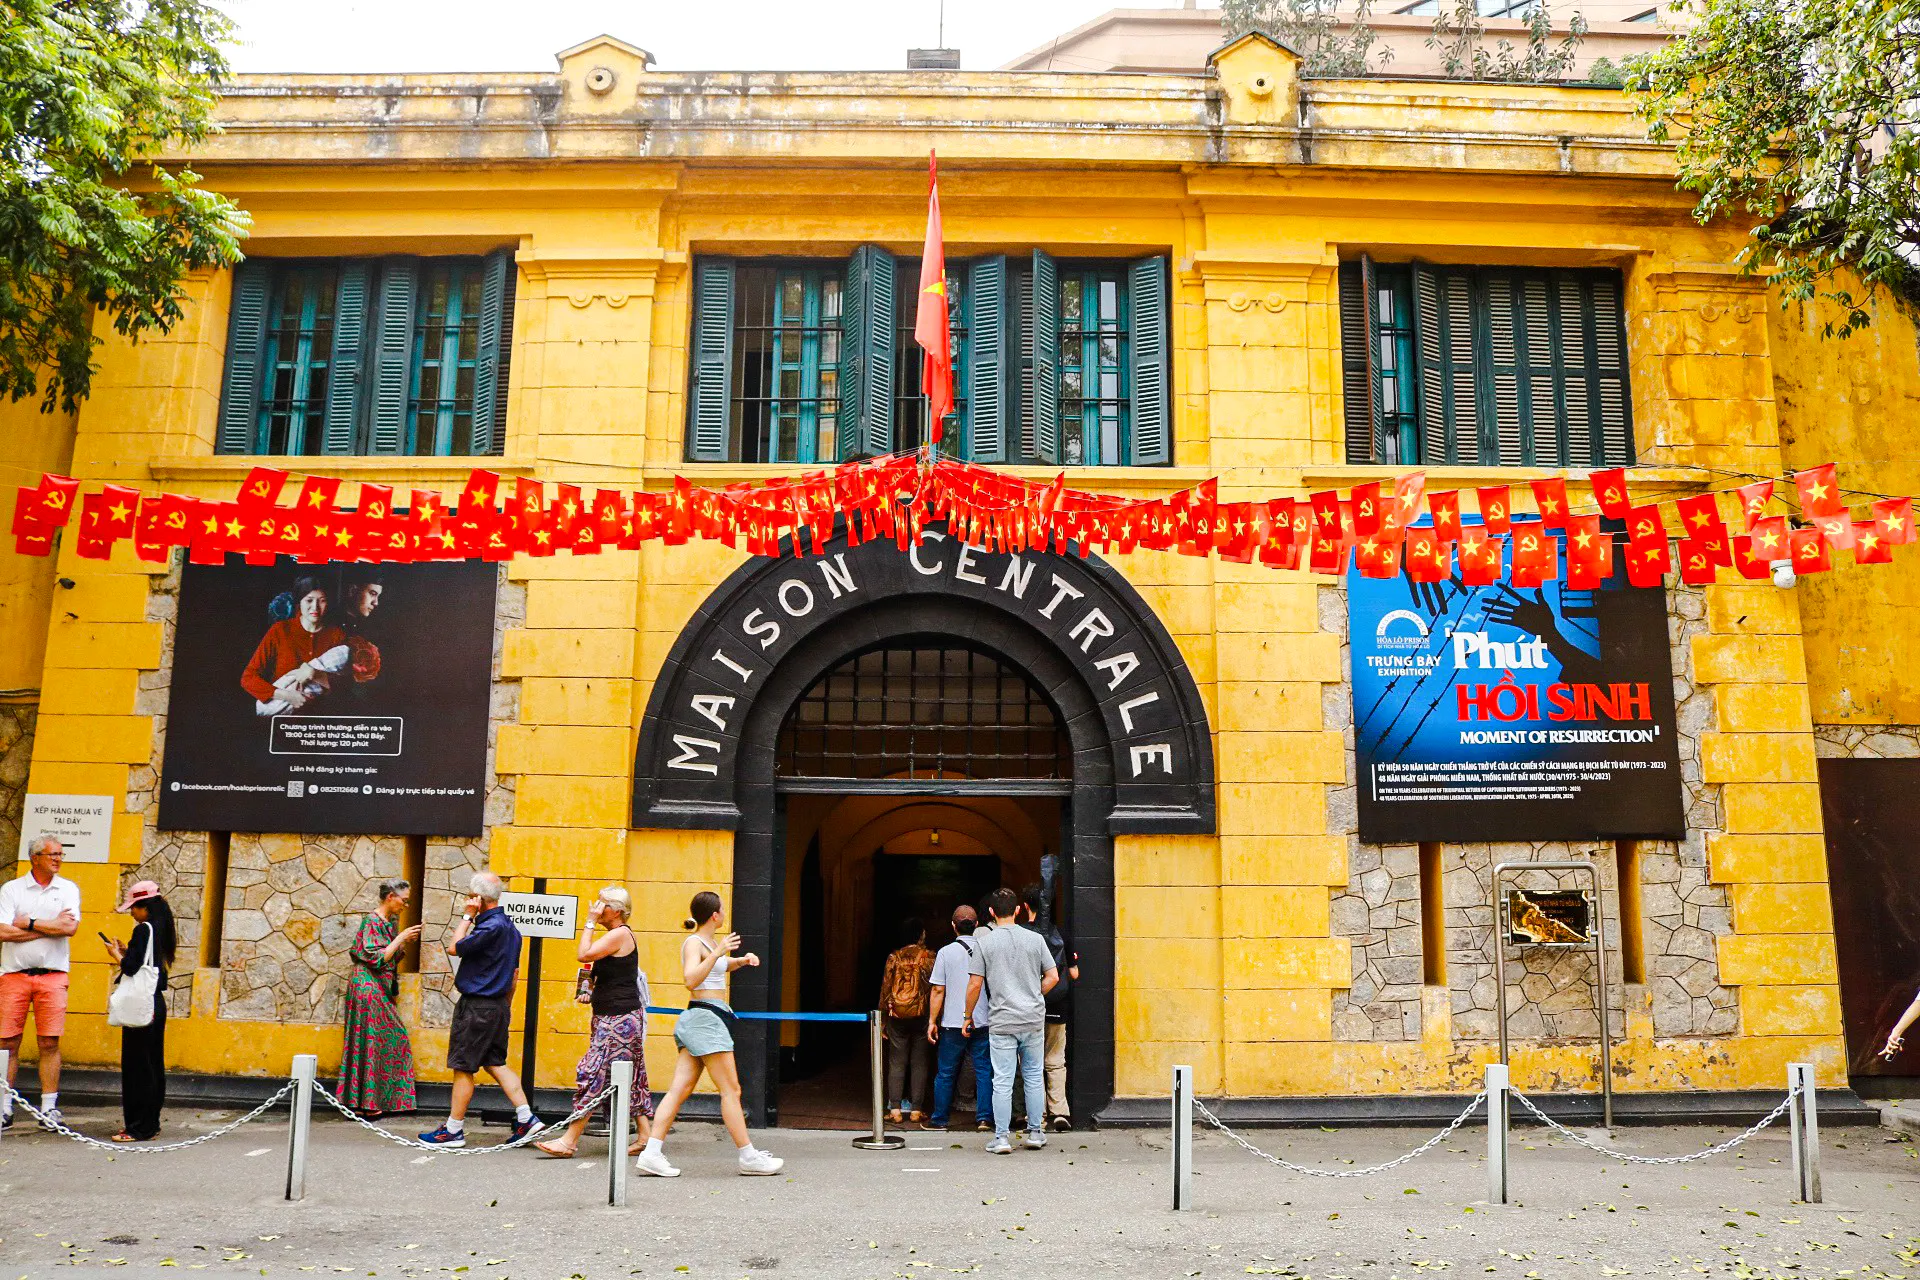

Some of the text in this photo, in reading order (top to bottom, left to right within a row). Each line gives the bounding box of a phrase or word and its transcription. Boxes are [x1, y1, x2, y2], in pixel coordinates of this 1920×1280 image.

[667, 530, 1173, 778] MAISON CENTRALE
[1366, 654, 1441, 666] TRƯNG BÀY
[1378, 668, 1432, 676] EXHIBITION
[1456, 669, 1652, 722] HỒI SINH
[1460, 731, 1528, 744] MOMENT
[1529, 730, 1549, 744] OF
[1631, 761, 1646, 769] (1973
[1650, 761, 1666, 769] 2023)
[1430, 773, 1450, 782] PHÓNG
[1546, 773, 1576, 781] (30/4/1975
[34, 805, 48, 814] XẾP
[51, 806, 72, 815] HÀNG
[507, 903, 565, 916] NƠI BÁN VÉ
[536, 917, 564, 926] Office
